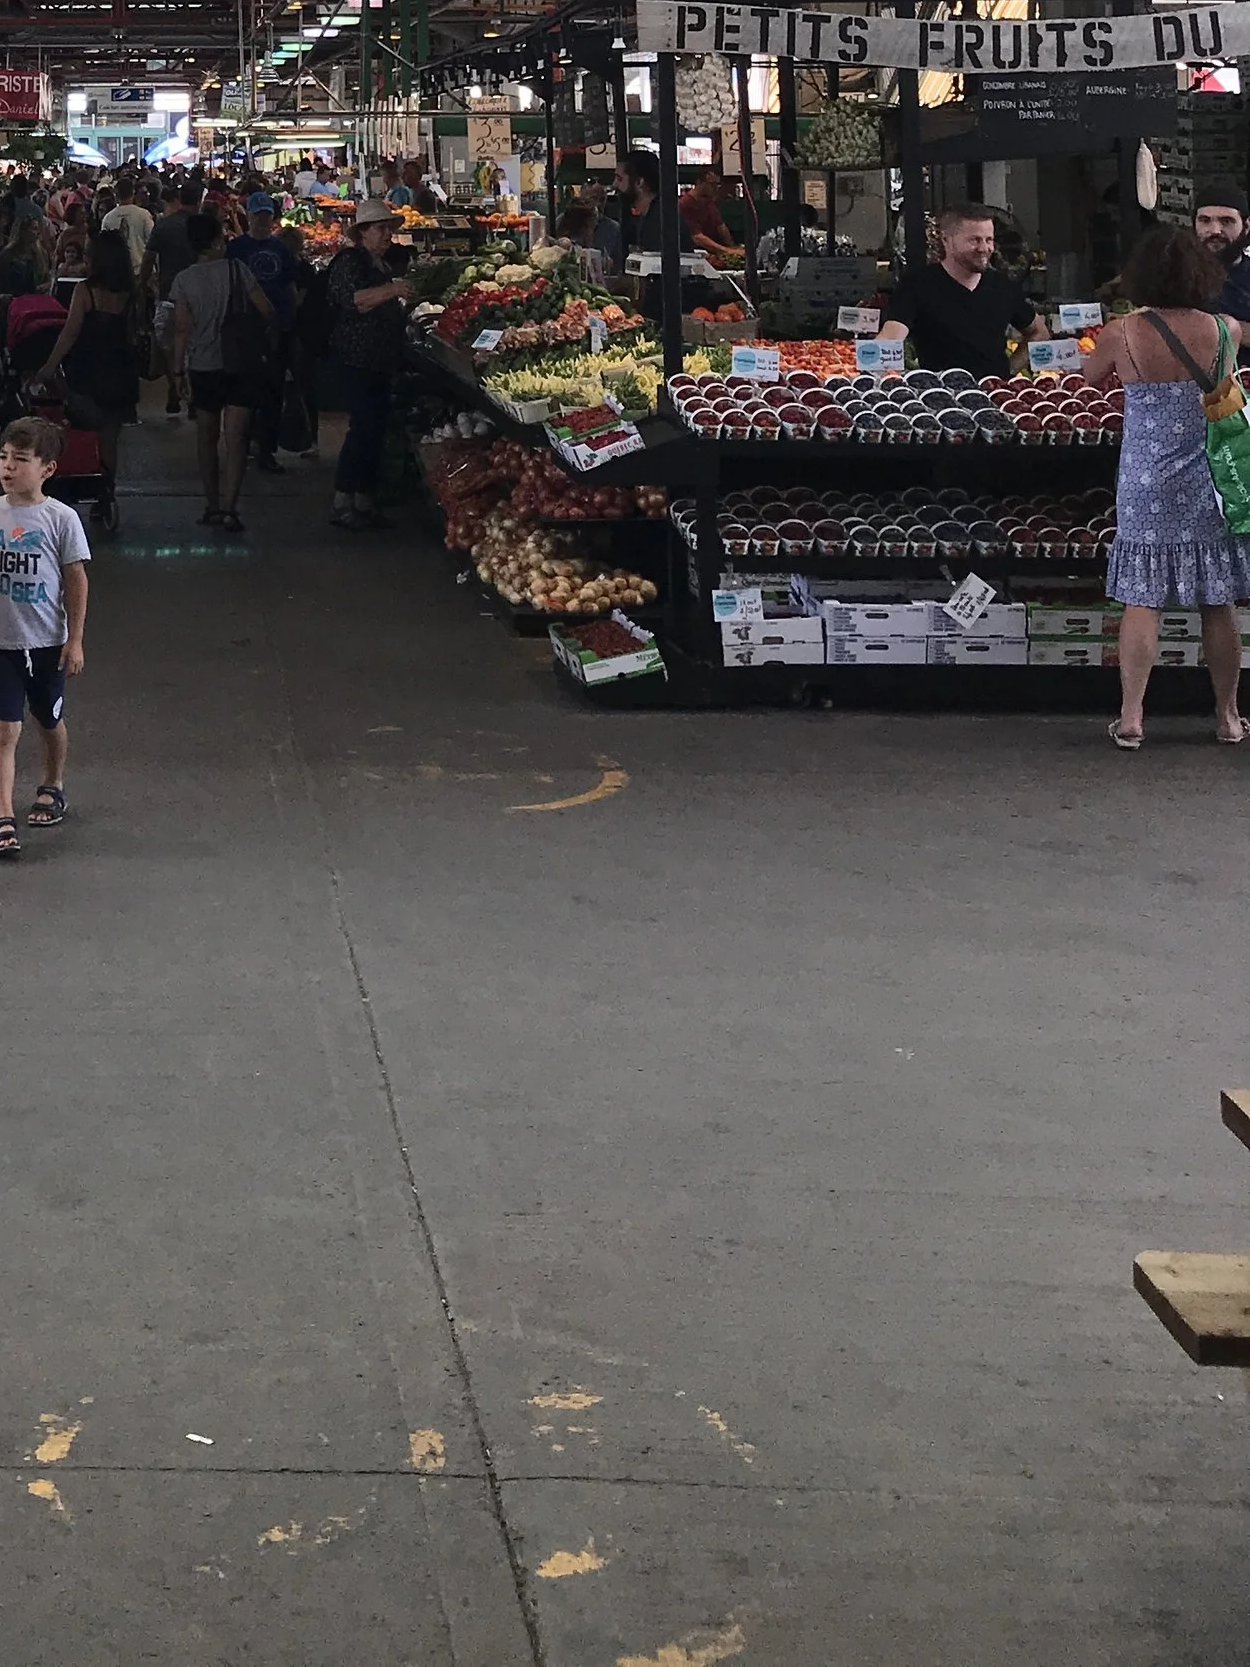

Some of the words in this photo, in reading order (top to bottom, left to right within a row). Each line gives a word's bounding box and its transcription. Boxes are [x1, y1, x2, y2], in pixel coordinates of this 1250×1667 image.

[676, 5, 868, 62] PETITS
[918, 21, 1114, 68] FRUITS
[1152, 11, 1224, 62] DU
[1085, 85, 1127, 95] AUBERGINE
[11, 581, 48, 604] SEA
